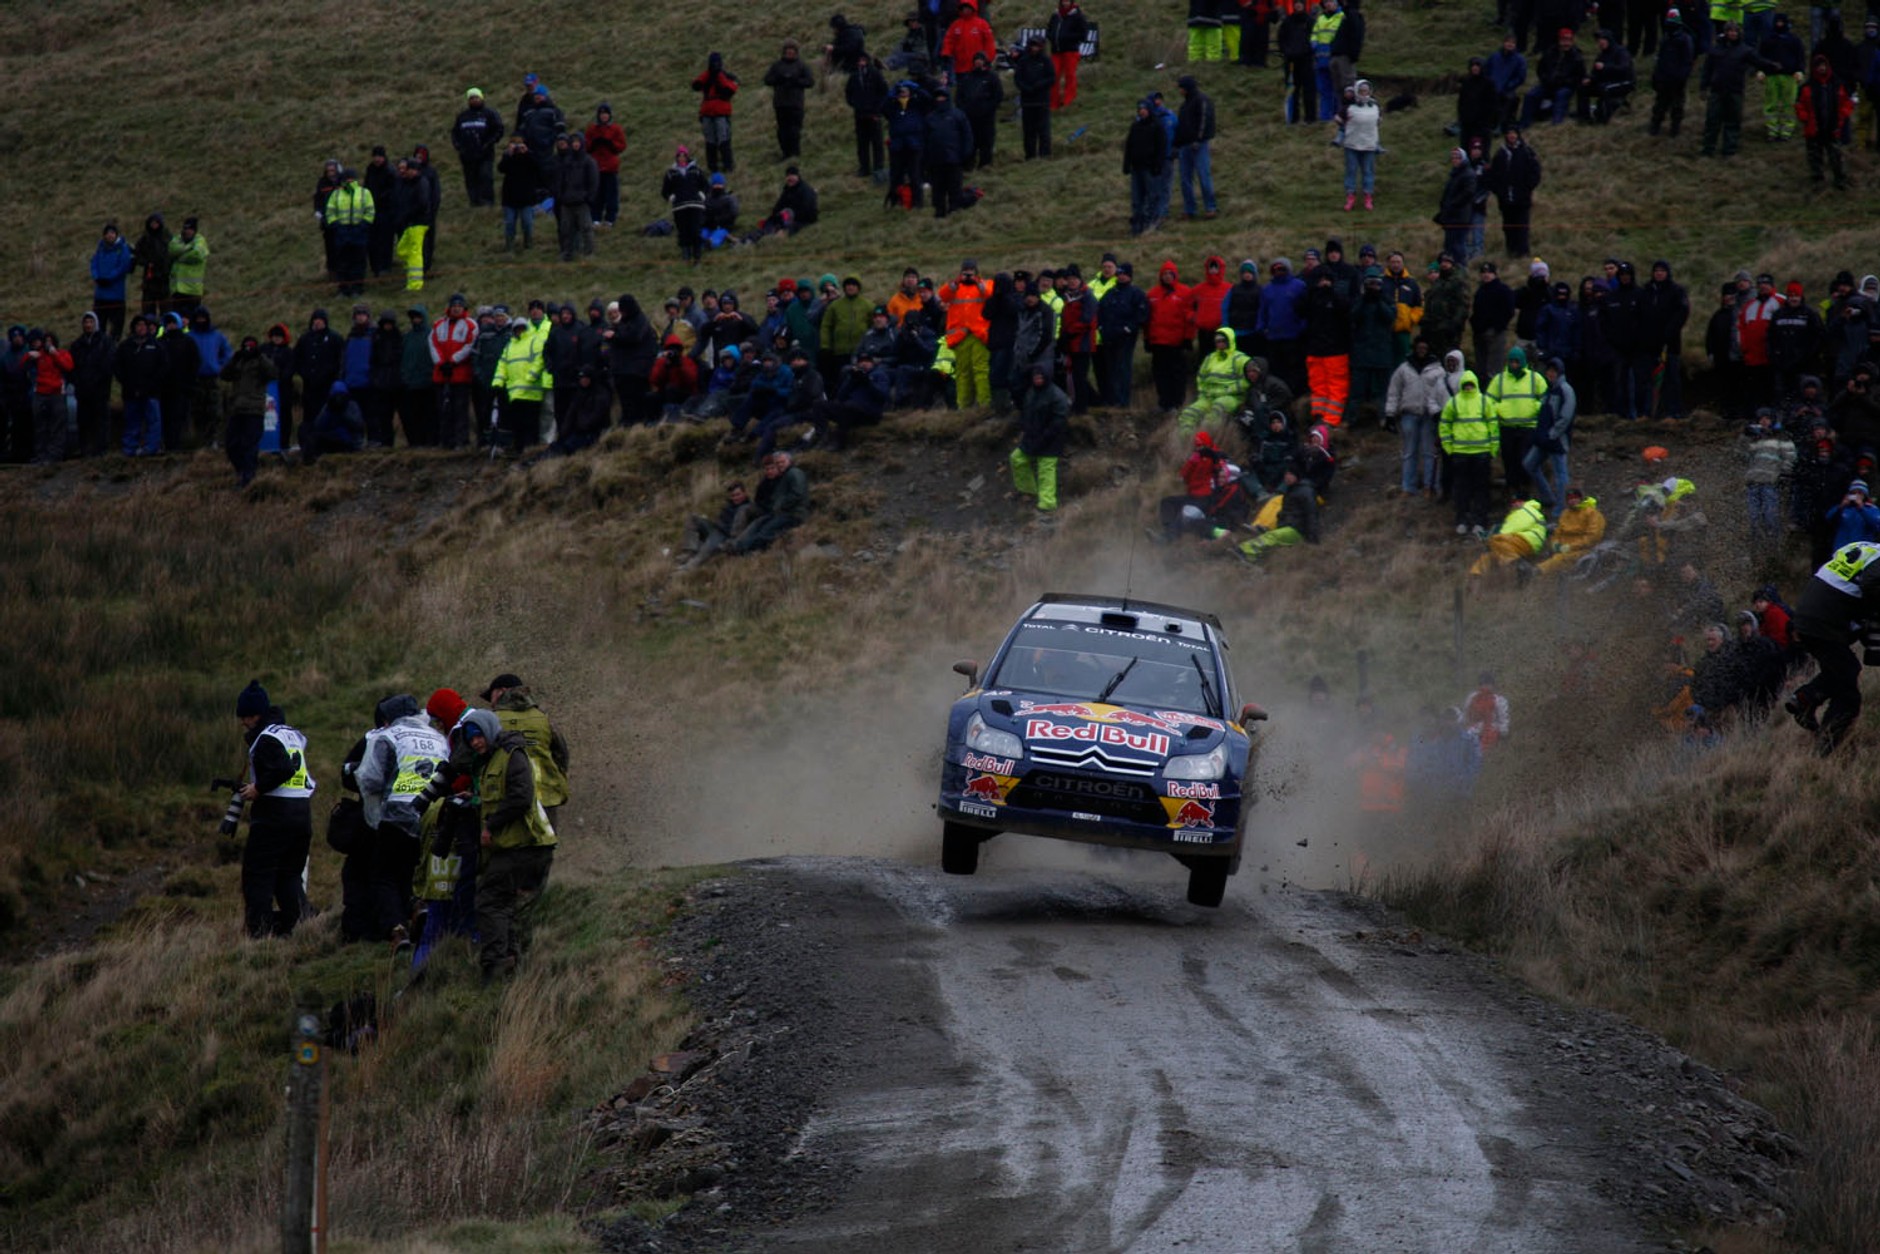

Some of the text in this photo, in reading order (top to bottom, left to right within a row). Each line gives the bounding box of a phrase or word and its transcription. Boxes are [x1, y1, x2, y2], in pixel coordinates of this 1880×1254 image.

[1176, 641, 1210, 652] TOTAL
[412, 738, 434, 750] 168
[1026, 719, 1170, 756] Red Bull
[982, 755, 1015, 776] Bull
[1167, 781, 1197, 798] Red
[960, 800, 997, 818] PIRELLI
